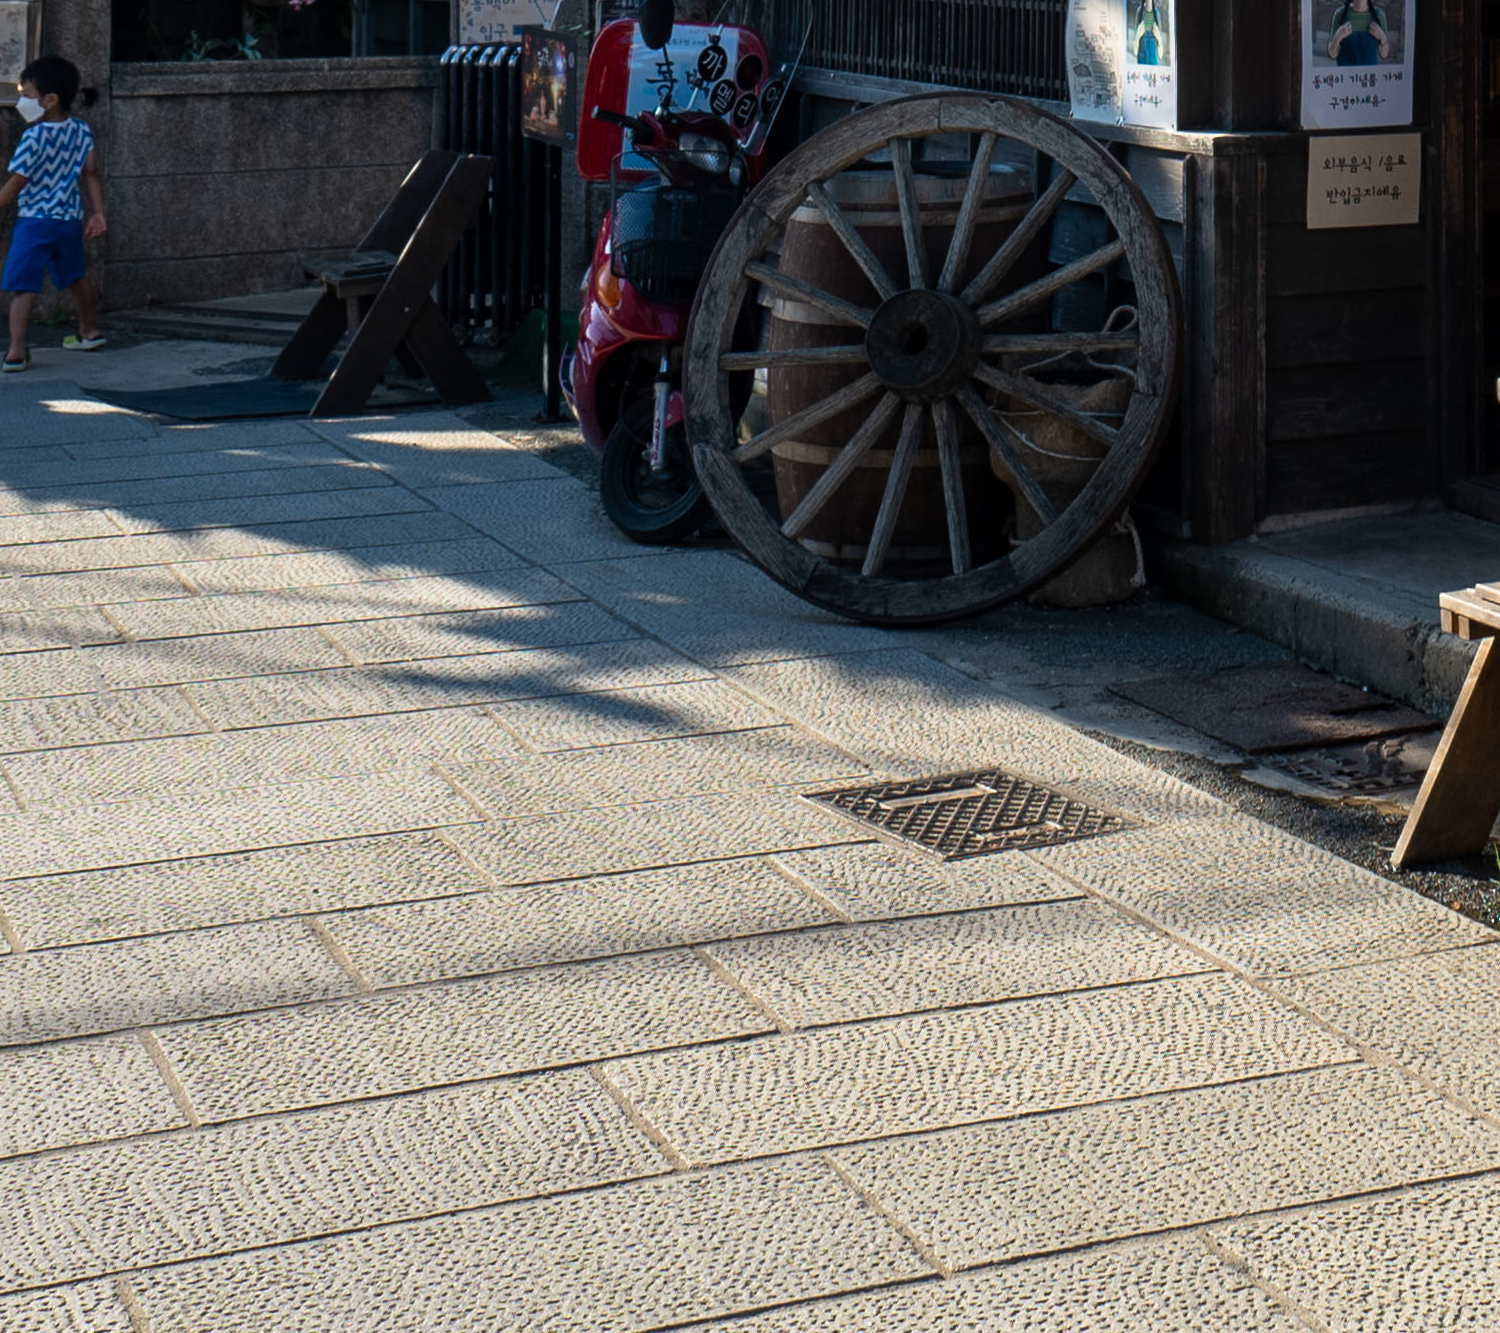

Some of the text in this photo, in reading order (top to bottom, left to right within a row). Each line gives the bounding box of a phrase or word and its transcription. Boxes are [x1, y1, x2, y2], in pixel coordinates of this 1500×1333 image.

[480, 23, 508, 42] 입구
[1313, 71, 1403, 89] 동백이 기념품 가게
[1323, 156, 1372, 174] 외부음식
[1326, 185, 1402, 205] 반입금지에유
